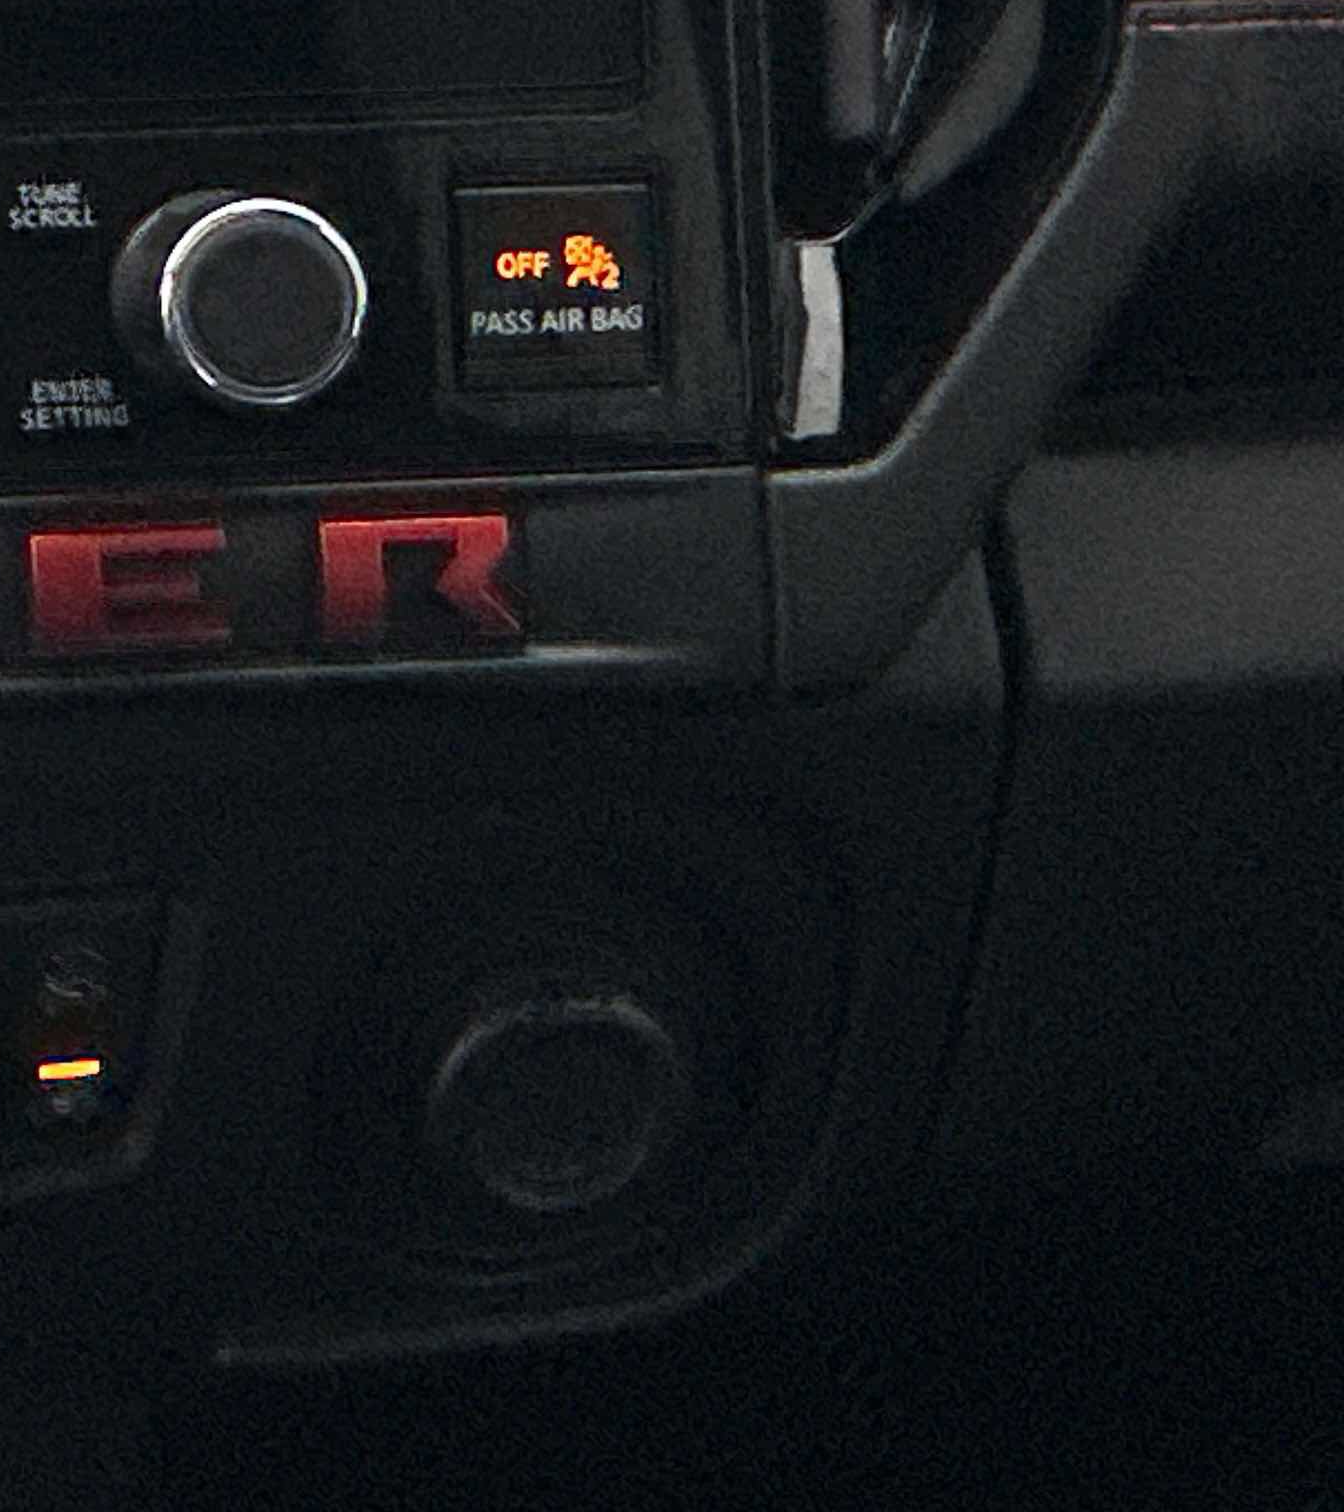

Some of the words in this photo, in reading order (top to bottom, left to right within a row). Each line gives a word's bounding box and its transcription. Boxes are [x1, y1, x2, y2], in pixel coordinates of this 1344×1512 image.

[8, 205, 97, 231] SCROLL
[496, 250, 550, 280] OFF
[471, 311, 536, 336] PASS
[539, 307, 586, 333] AIR
[592, 305, 644, 330] BAG
